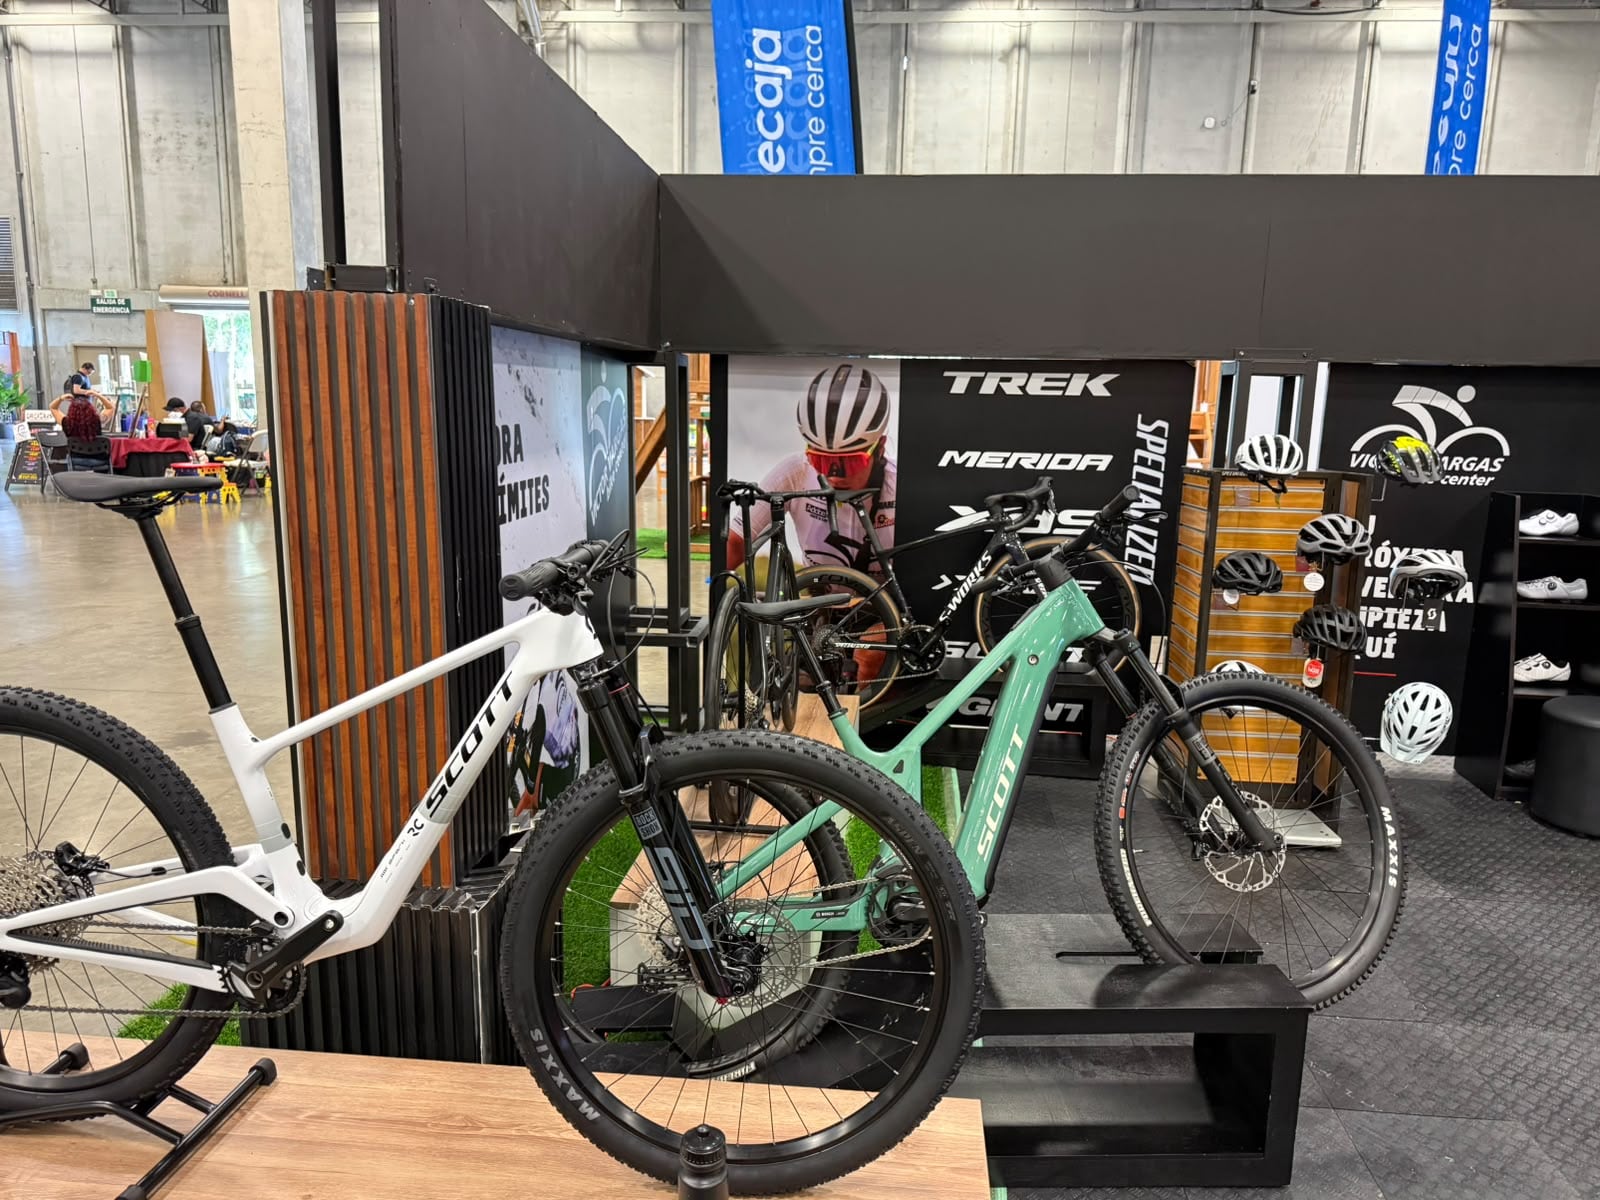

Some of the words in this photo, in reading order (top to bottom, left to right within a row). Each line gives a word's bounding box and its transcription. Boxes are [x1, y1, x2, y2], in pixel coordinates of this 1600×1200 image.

[805, 25, 825, 108] cerca
[1460, 23, 1482, 120] cerca
[92, 306, 130, 314] EMERGENCIA
[943, 371, 1121, 398] TREK
[938, 450, 1114, 472] MERIDA
[938, 550, 993, 622] S-WORKS
[426, 670, 513, 818] SCOTT
[407, 818, 424, 837] RC
[977, 723, 1024, 862] SCOTT
[1380, 806, 1399, 888] MAXXIS
[529, 1028, 600, 1121] MAXXIS
